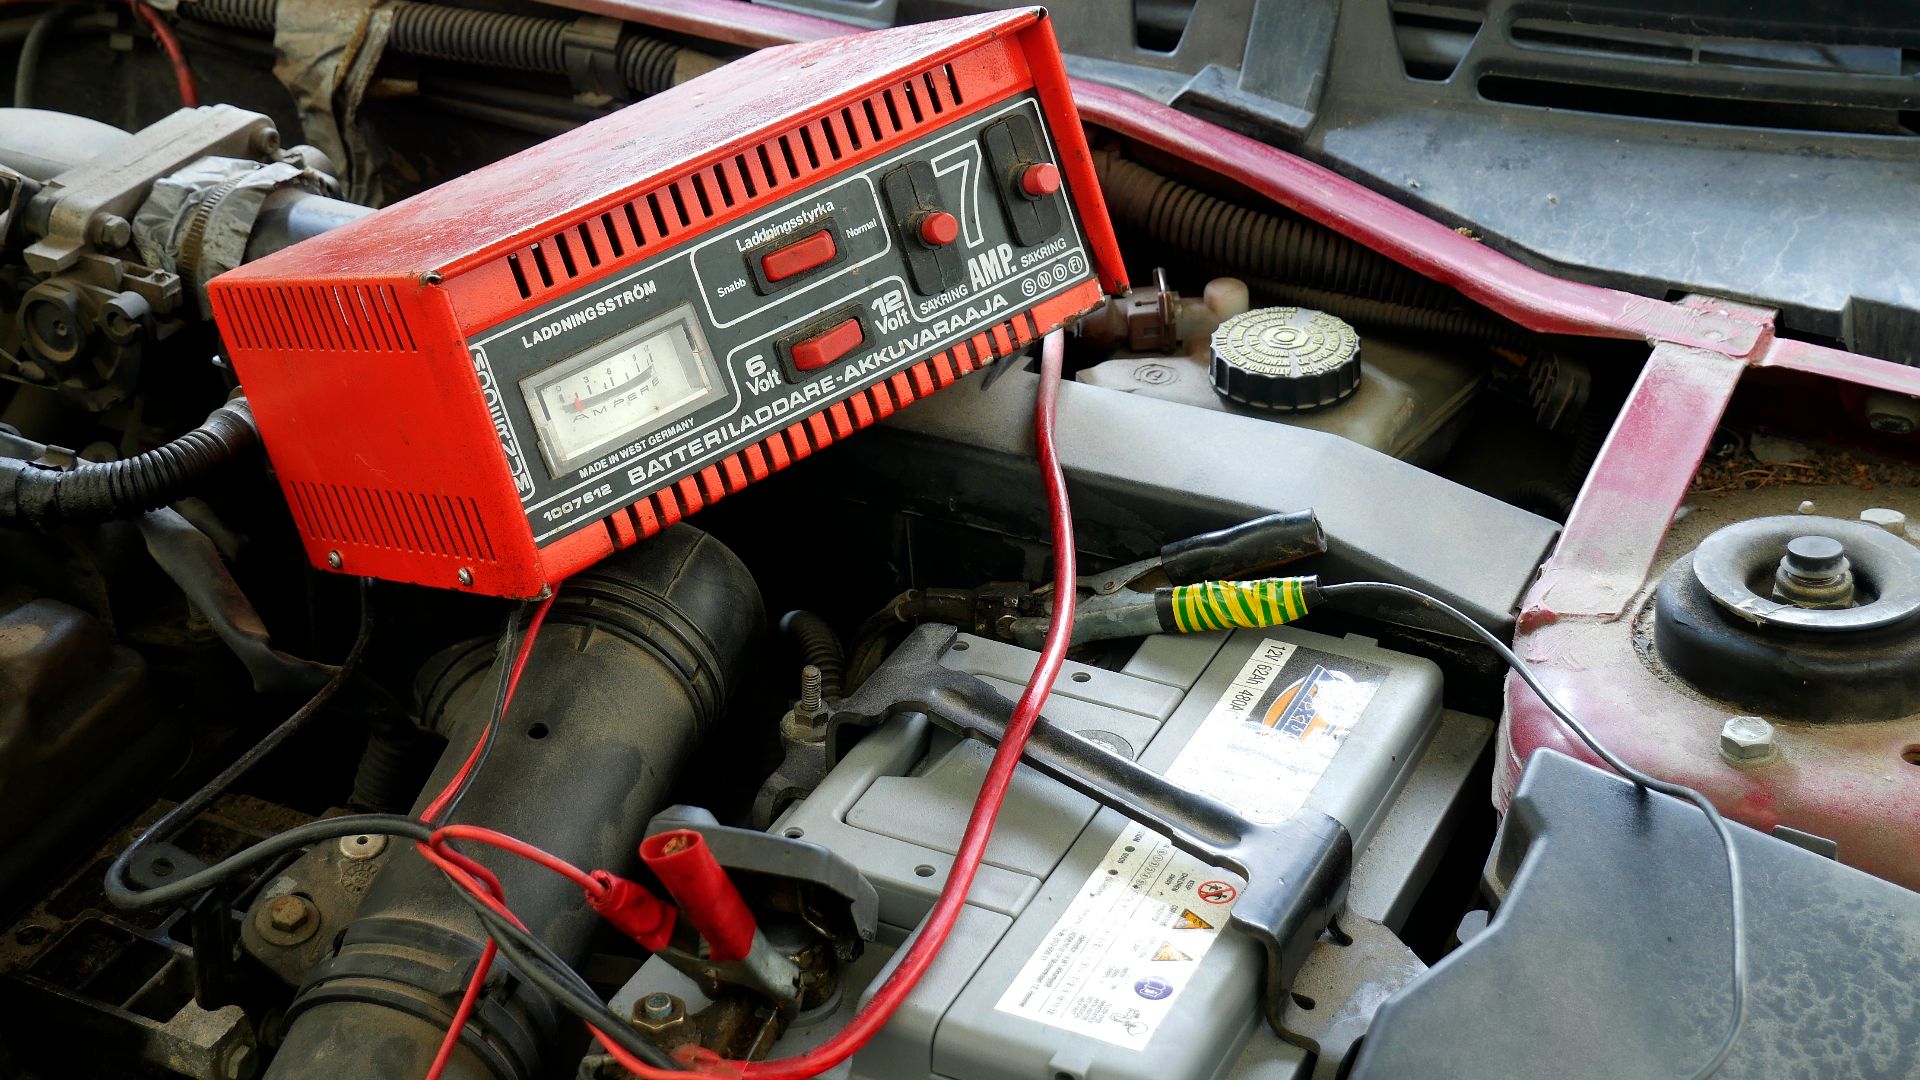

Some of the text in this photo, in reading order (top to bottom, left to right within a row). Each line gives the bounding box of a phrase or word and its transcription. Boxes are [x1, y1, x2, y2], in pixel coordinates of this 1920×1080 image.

[930, 139, 983, 249] 7
[736, 200, 836, 253] Laddningsstyrka
[846, 218, 877, 240] Normal
[1020, 237, 1066, 267] SÄKRING
[967, 243, 1017, 292] AMP.
[717, 277, 747, 298] Snabb
[920, 284, 969, 315] SÄKRING
[521, 280, 657, 348] LADDNINGSSTRÖM
[871, 289, 902, 315] 12
[875, 309, 910, 335] Volt
[606, 367, 612, 375] 6
[745, 354, 767, 375] 6
[746, 372, 782, 397] Volt
[573, 376, 660, 423] AMPERE
[579, 417, 695, 479] MADE IN WEST GERMANY
[543, 484, 613, 522] 1007612
[1264, 645, 1286, 662] 12V
[1246, 664, 1272, 685] 62Ah
